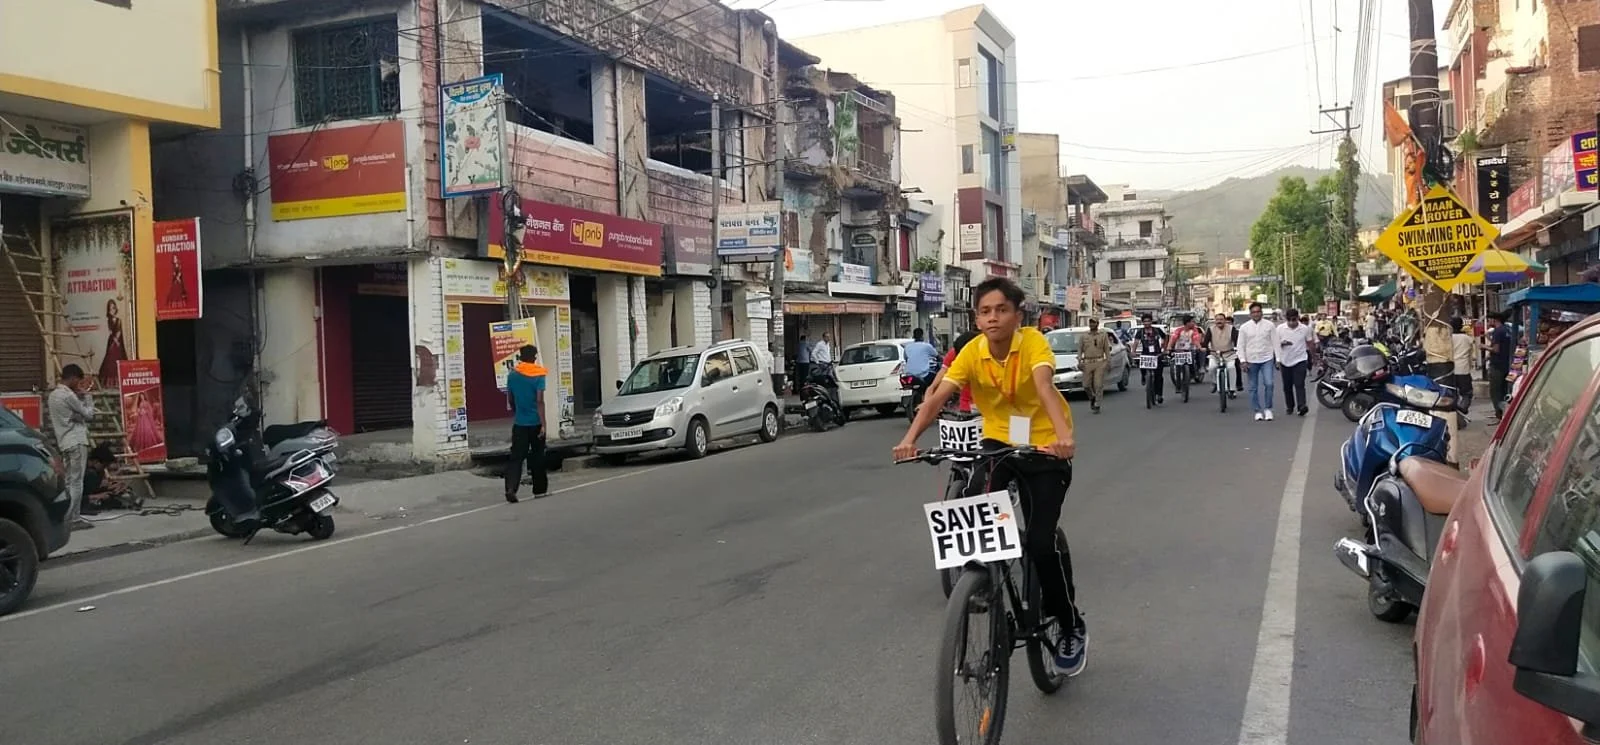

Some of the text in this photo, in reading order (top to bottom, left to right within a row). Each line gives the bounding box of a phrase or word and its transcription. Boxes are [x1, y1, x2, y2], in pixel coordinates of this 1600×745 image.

[6, 124, 87, 165] ज्वैलर्स
[1423, 199, 1454, 212] MAAN
[1414, 208, 1463, 224] SAROVER
[585, 227, 602, 242] pnb
[1398, 222, 1484, 247] SWIMMING POOL
[156, 240, 196, 254] ATTRACTION
[1408, 239, 1478, 258] RESTAURANT
[67, 278, 117, 294] ATTRACTION
[122, 376, 160, 386] ATTRACTION
[940, 424, 978, 442] SAVE
[930, 502, 993, 535] SAVE
[937, 526, 1016, 560] FUEL
